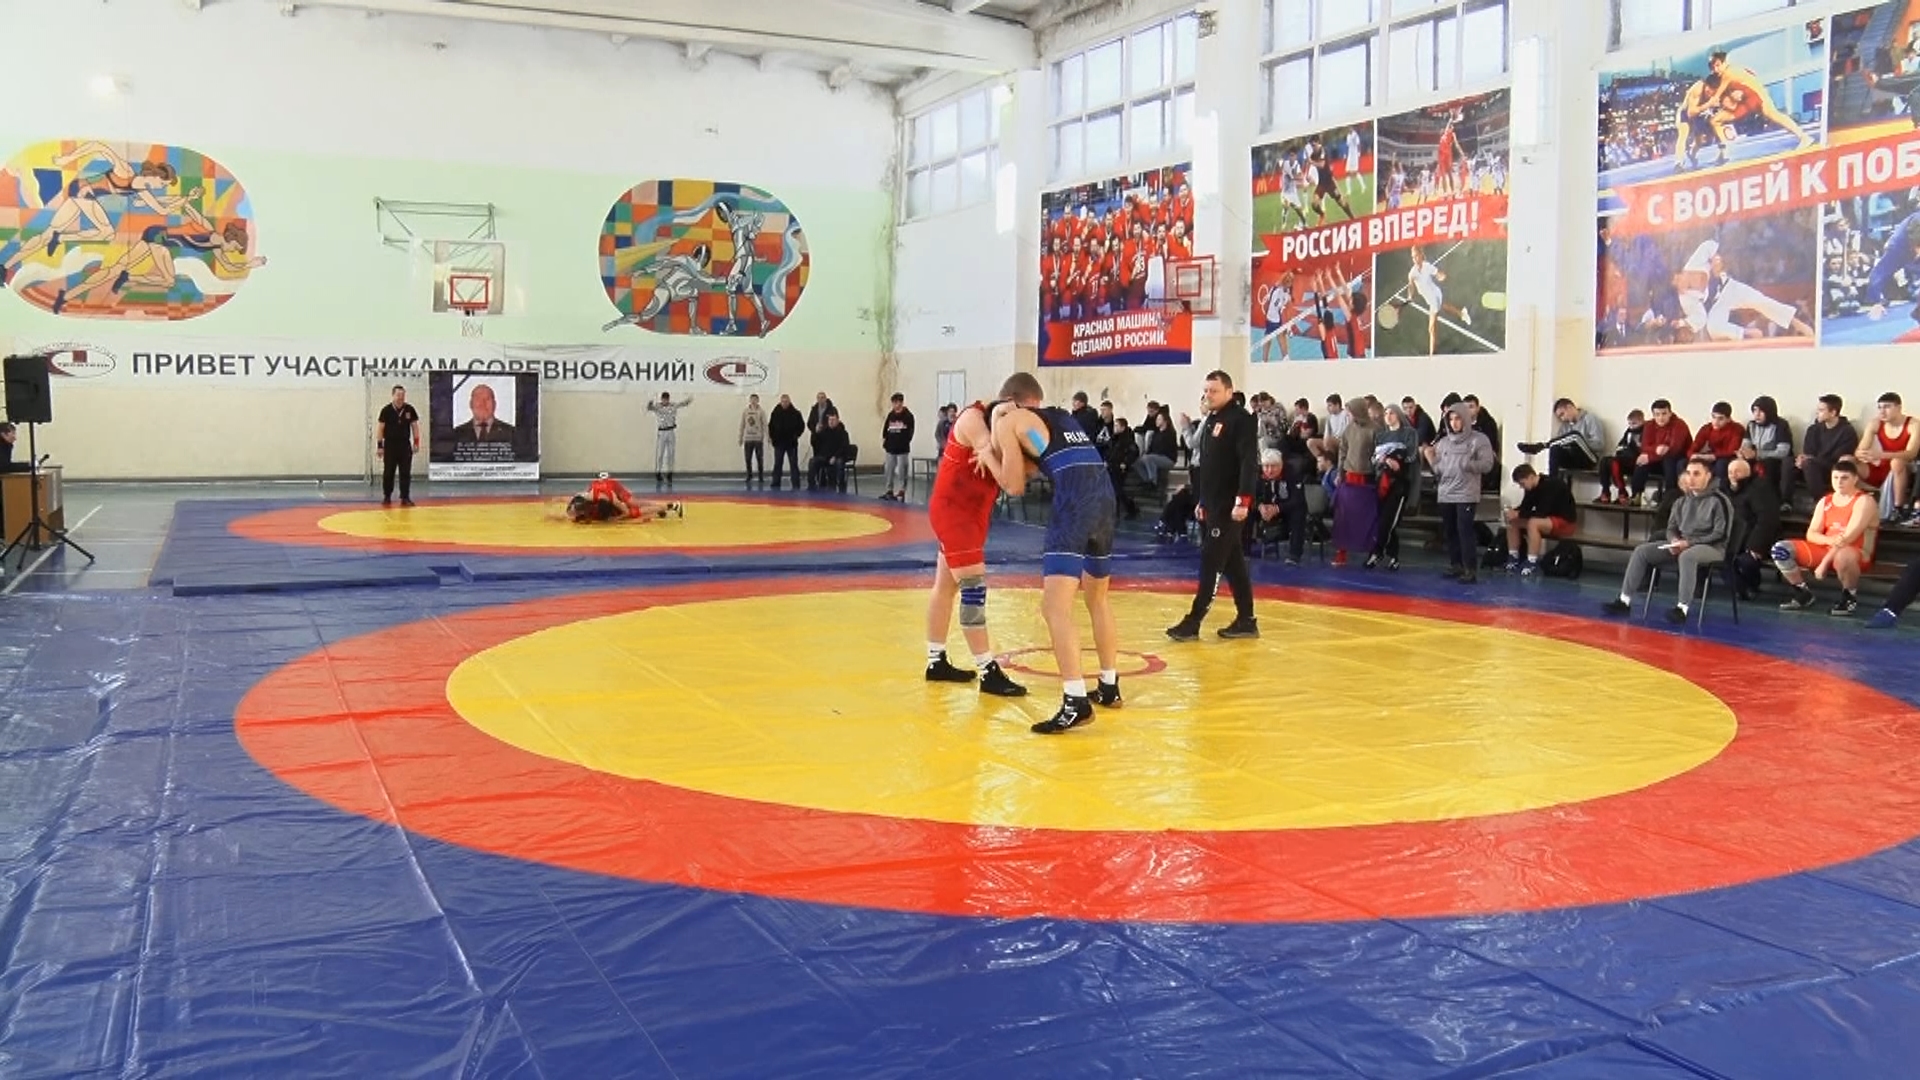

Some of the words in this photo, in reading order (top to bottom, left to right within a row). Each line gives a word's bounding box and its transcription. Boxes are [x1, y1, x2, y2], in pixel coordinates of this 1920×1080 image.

[1647, 193, 1664, 225] С
[1673, 162, 1789, 223] ВОЛЕЙ
[1801, 160, 1828, 197] К
[1282, 222, 1361, 262] РОССИЯ
[1368, 201, 1479, 246] ВПЕРЕД!
[1073, 319, 1114, 338] КРАСНАЯ
[1071, 338, 1113, 357] СДЕЛАНО
[1114, 334, 1122, 348] В
[1124, 331, 1167, 347] РОССИИ.
[132, 353, 255, 376] ПРИВЕТ
